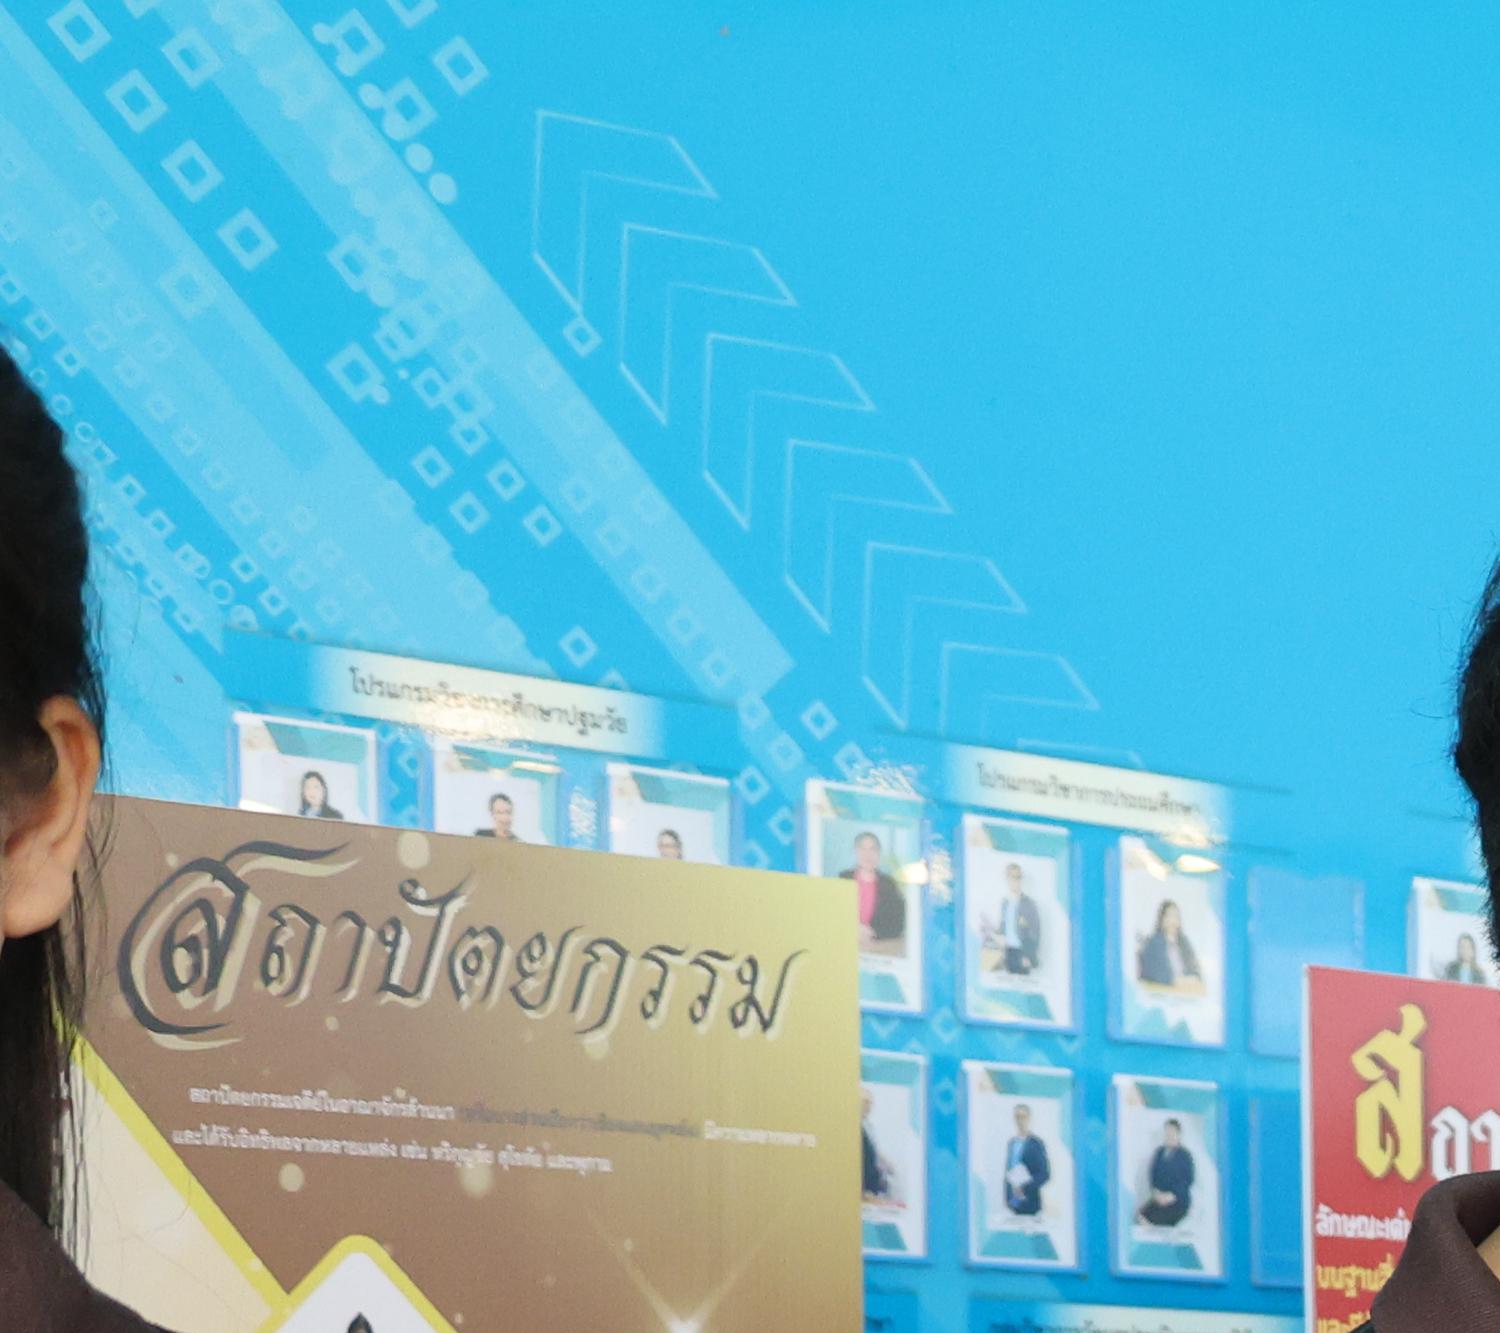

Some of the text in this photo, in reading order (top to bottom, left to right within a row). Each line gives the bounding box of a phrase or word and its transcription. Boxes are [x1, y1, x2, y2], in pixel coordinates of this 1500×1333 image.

[118, 840, 806, 1038] สถาปัตยกรรม
